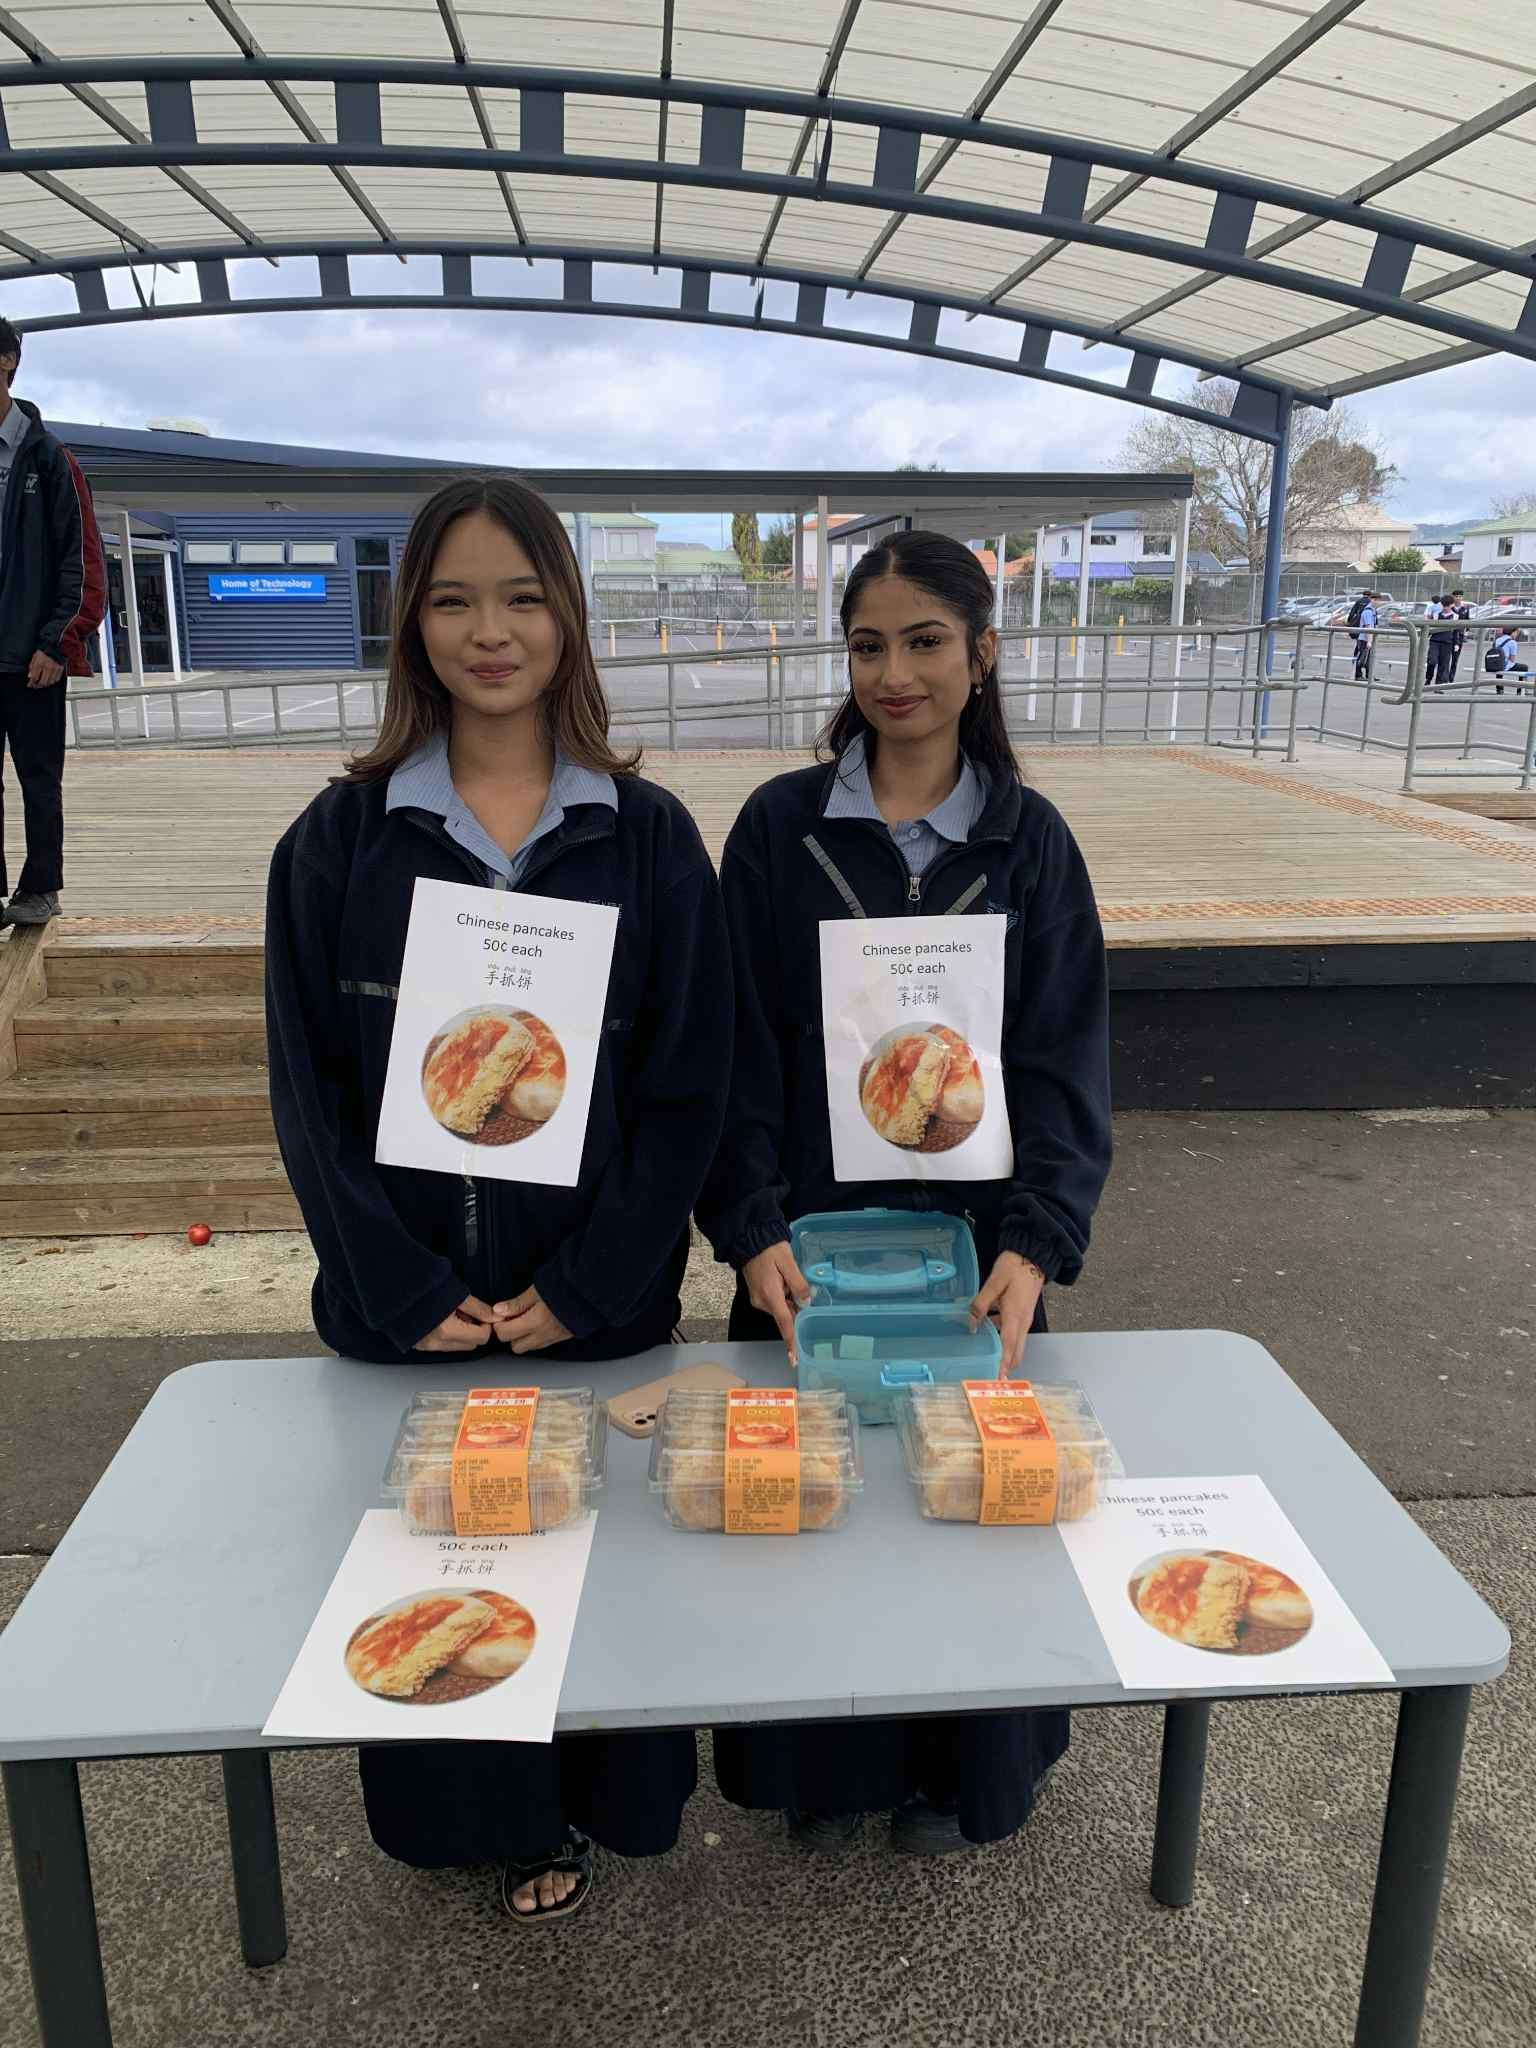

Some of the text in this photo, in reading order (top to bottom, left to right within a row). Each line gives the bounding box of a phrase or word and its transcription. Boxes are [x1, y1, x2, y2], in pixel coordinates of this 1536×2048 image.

[221, 579, 312, 589] Home of Technology
[456, 913, 575, 941] Chinese pancakes
[483, 938, 543, 958] 50¢ each
[862, 940, 973, 956] Chinese pancakes
[890, 962, 946, 976] 50¢ each
[484, 970, 533, 990] 手抓饼
[897, 991, 940, 1006] 手抓饼
[1159, 1492, 1229, 1505] pancakes
[1168, 1506, 1205, 1517] each
[437, 1540, 508, 1553] 50¢ each
[438, 1562, 496, 1576] 手抓饼
